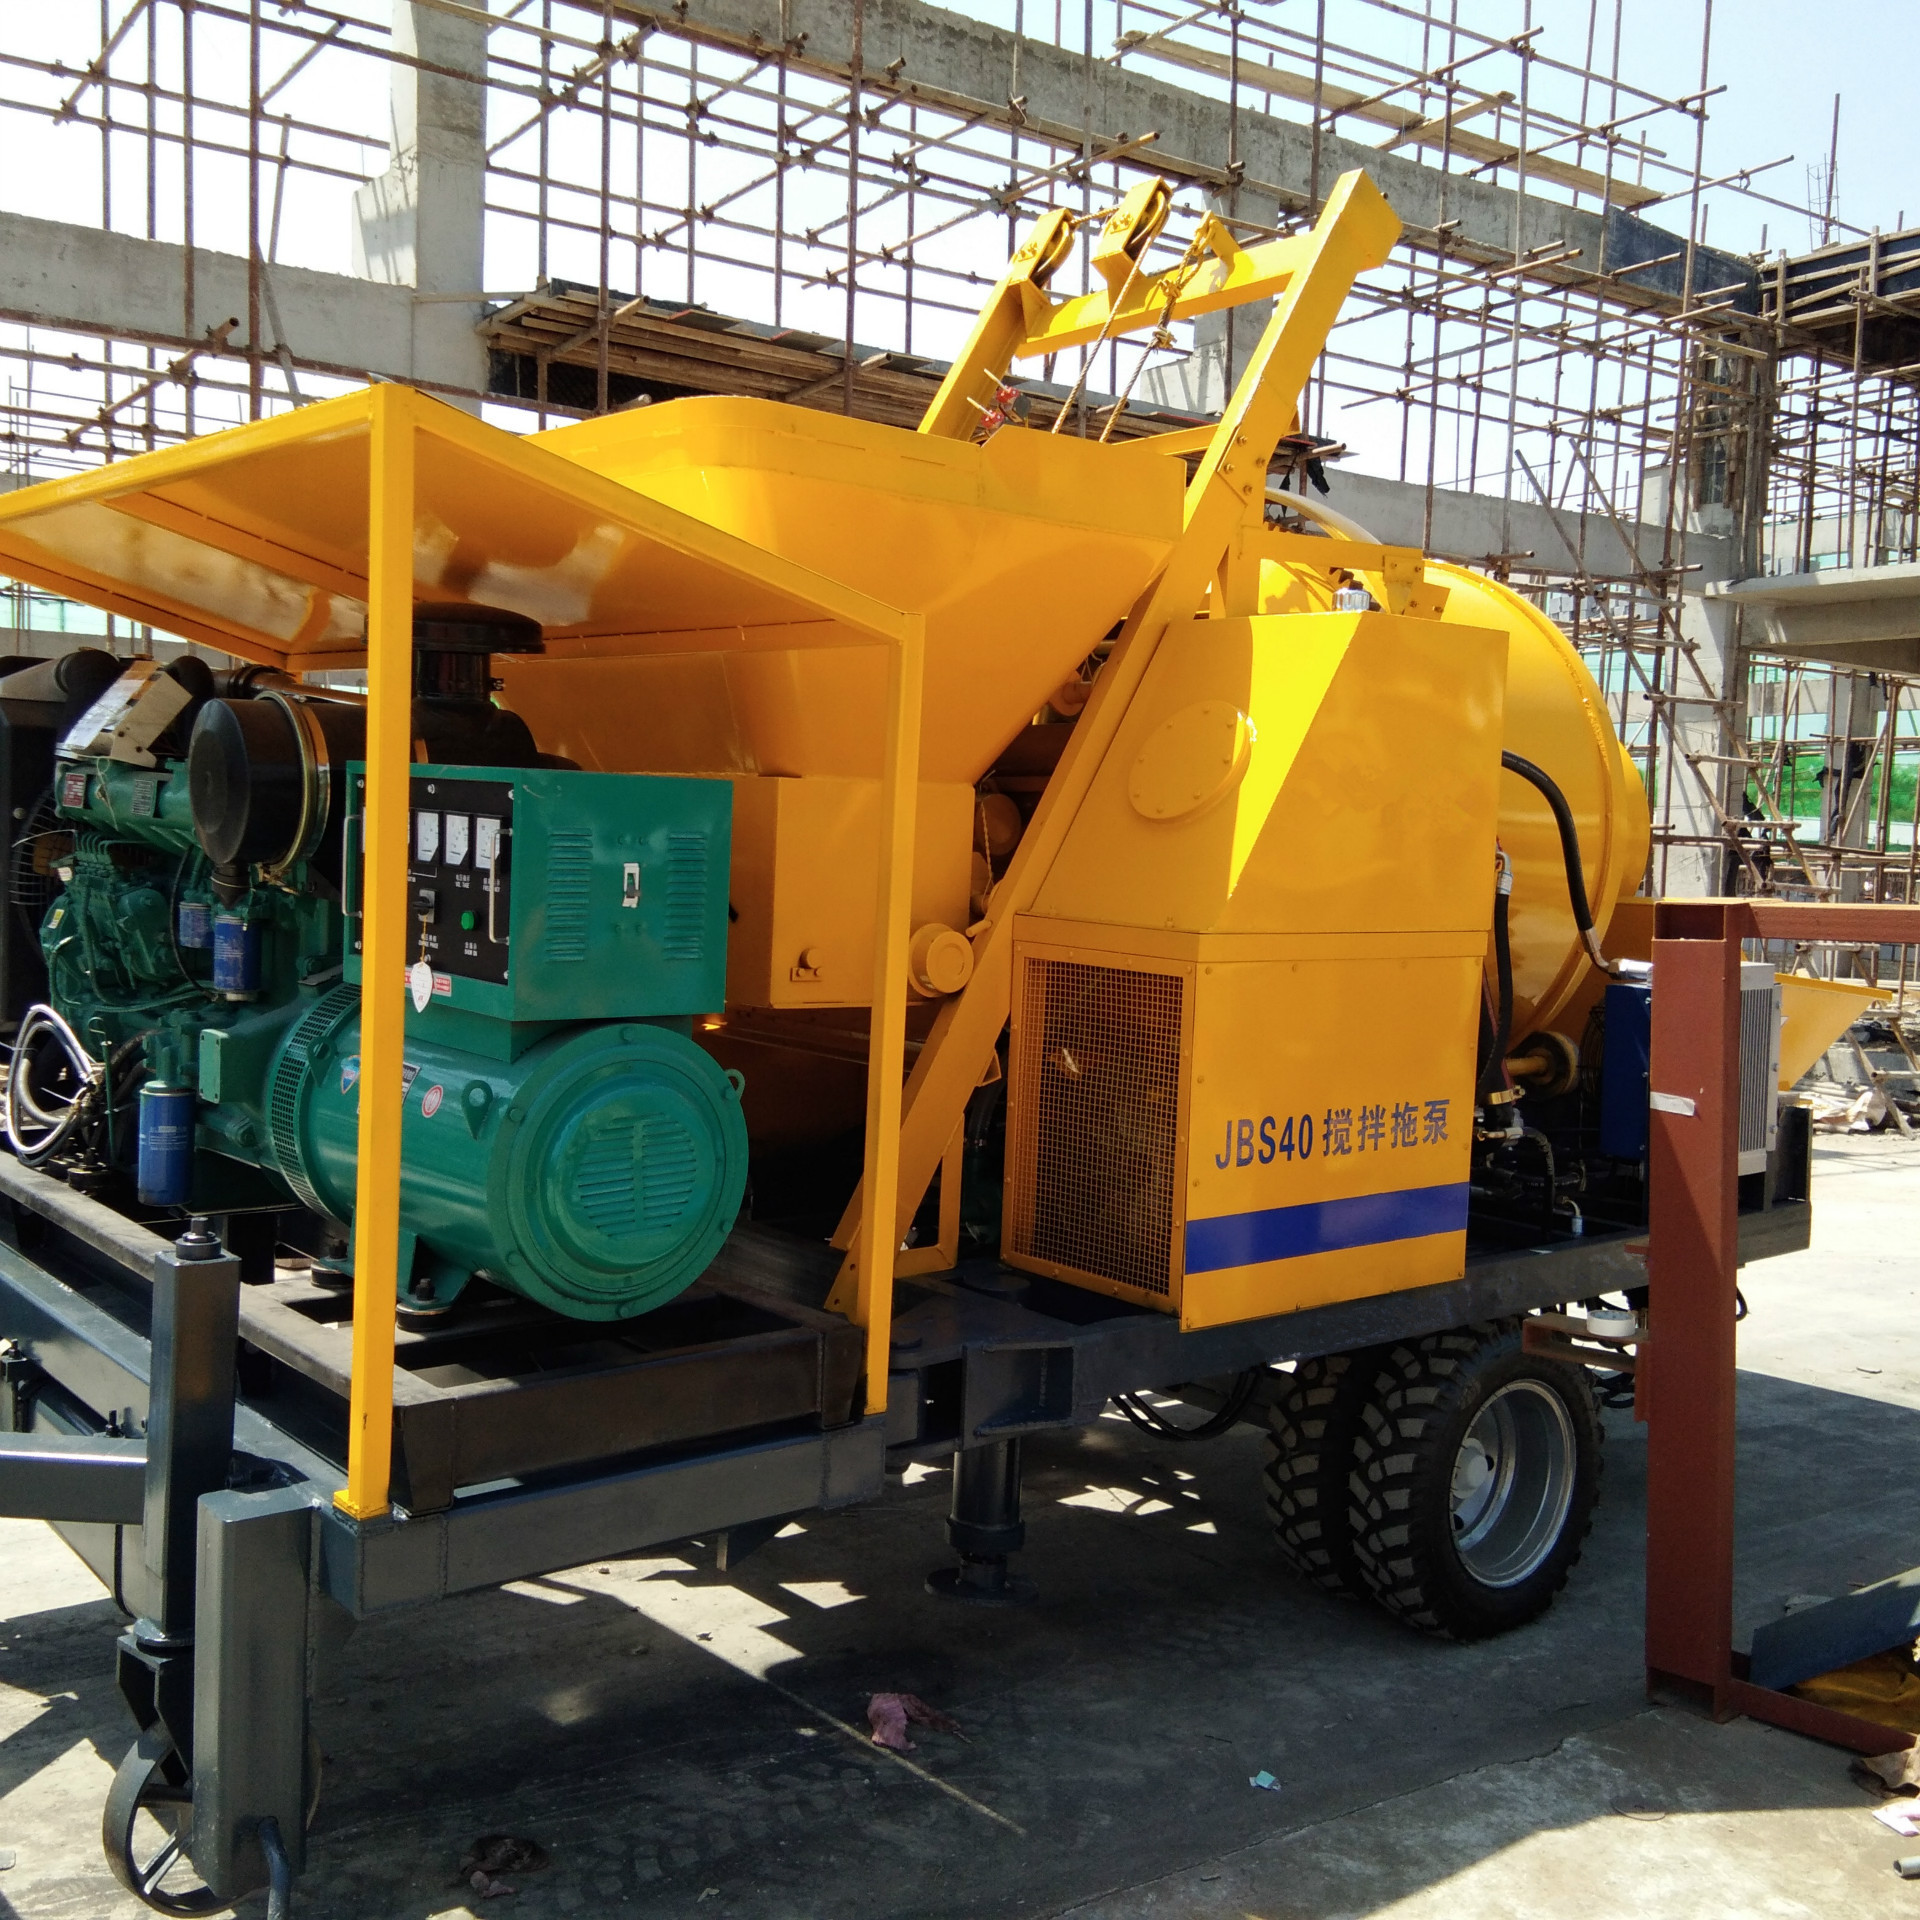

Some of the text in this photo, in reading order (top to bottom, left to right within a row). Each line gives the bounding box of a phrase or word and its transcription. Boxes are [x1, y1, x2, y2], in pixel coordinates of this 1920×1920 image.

[1215, 1098, 1451, 1170] JBS40 搅拌拖泵
